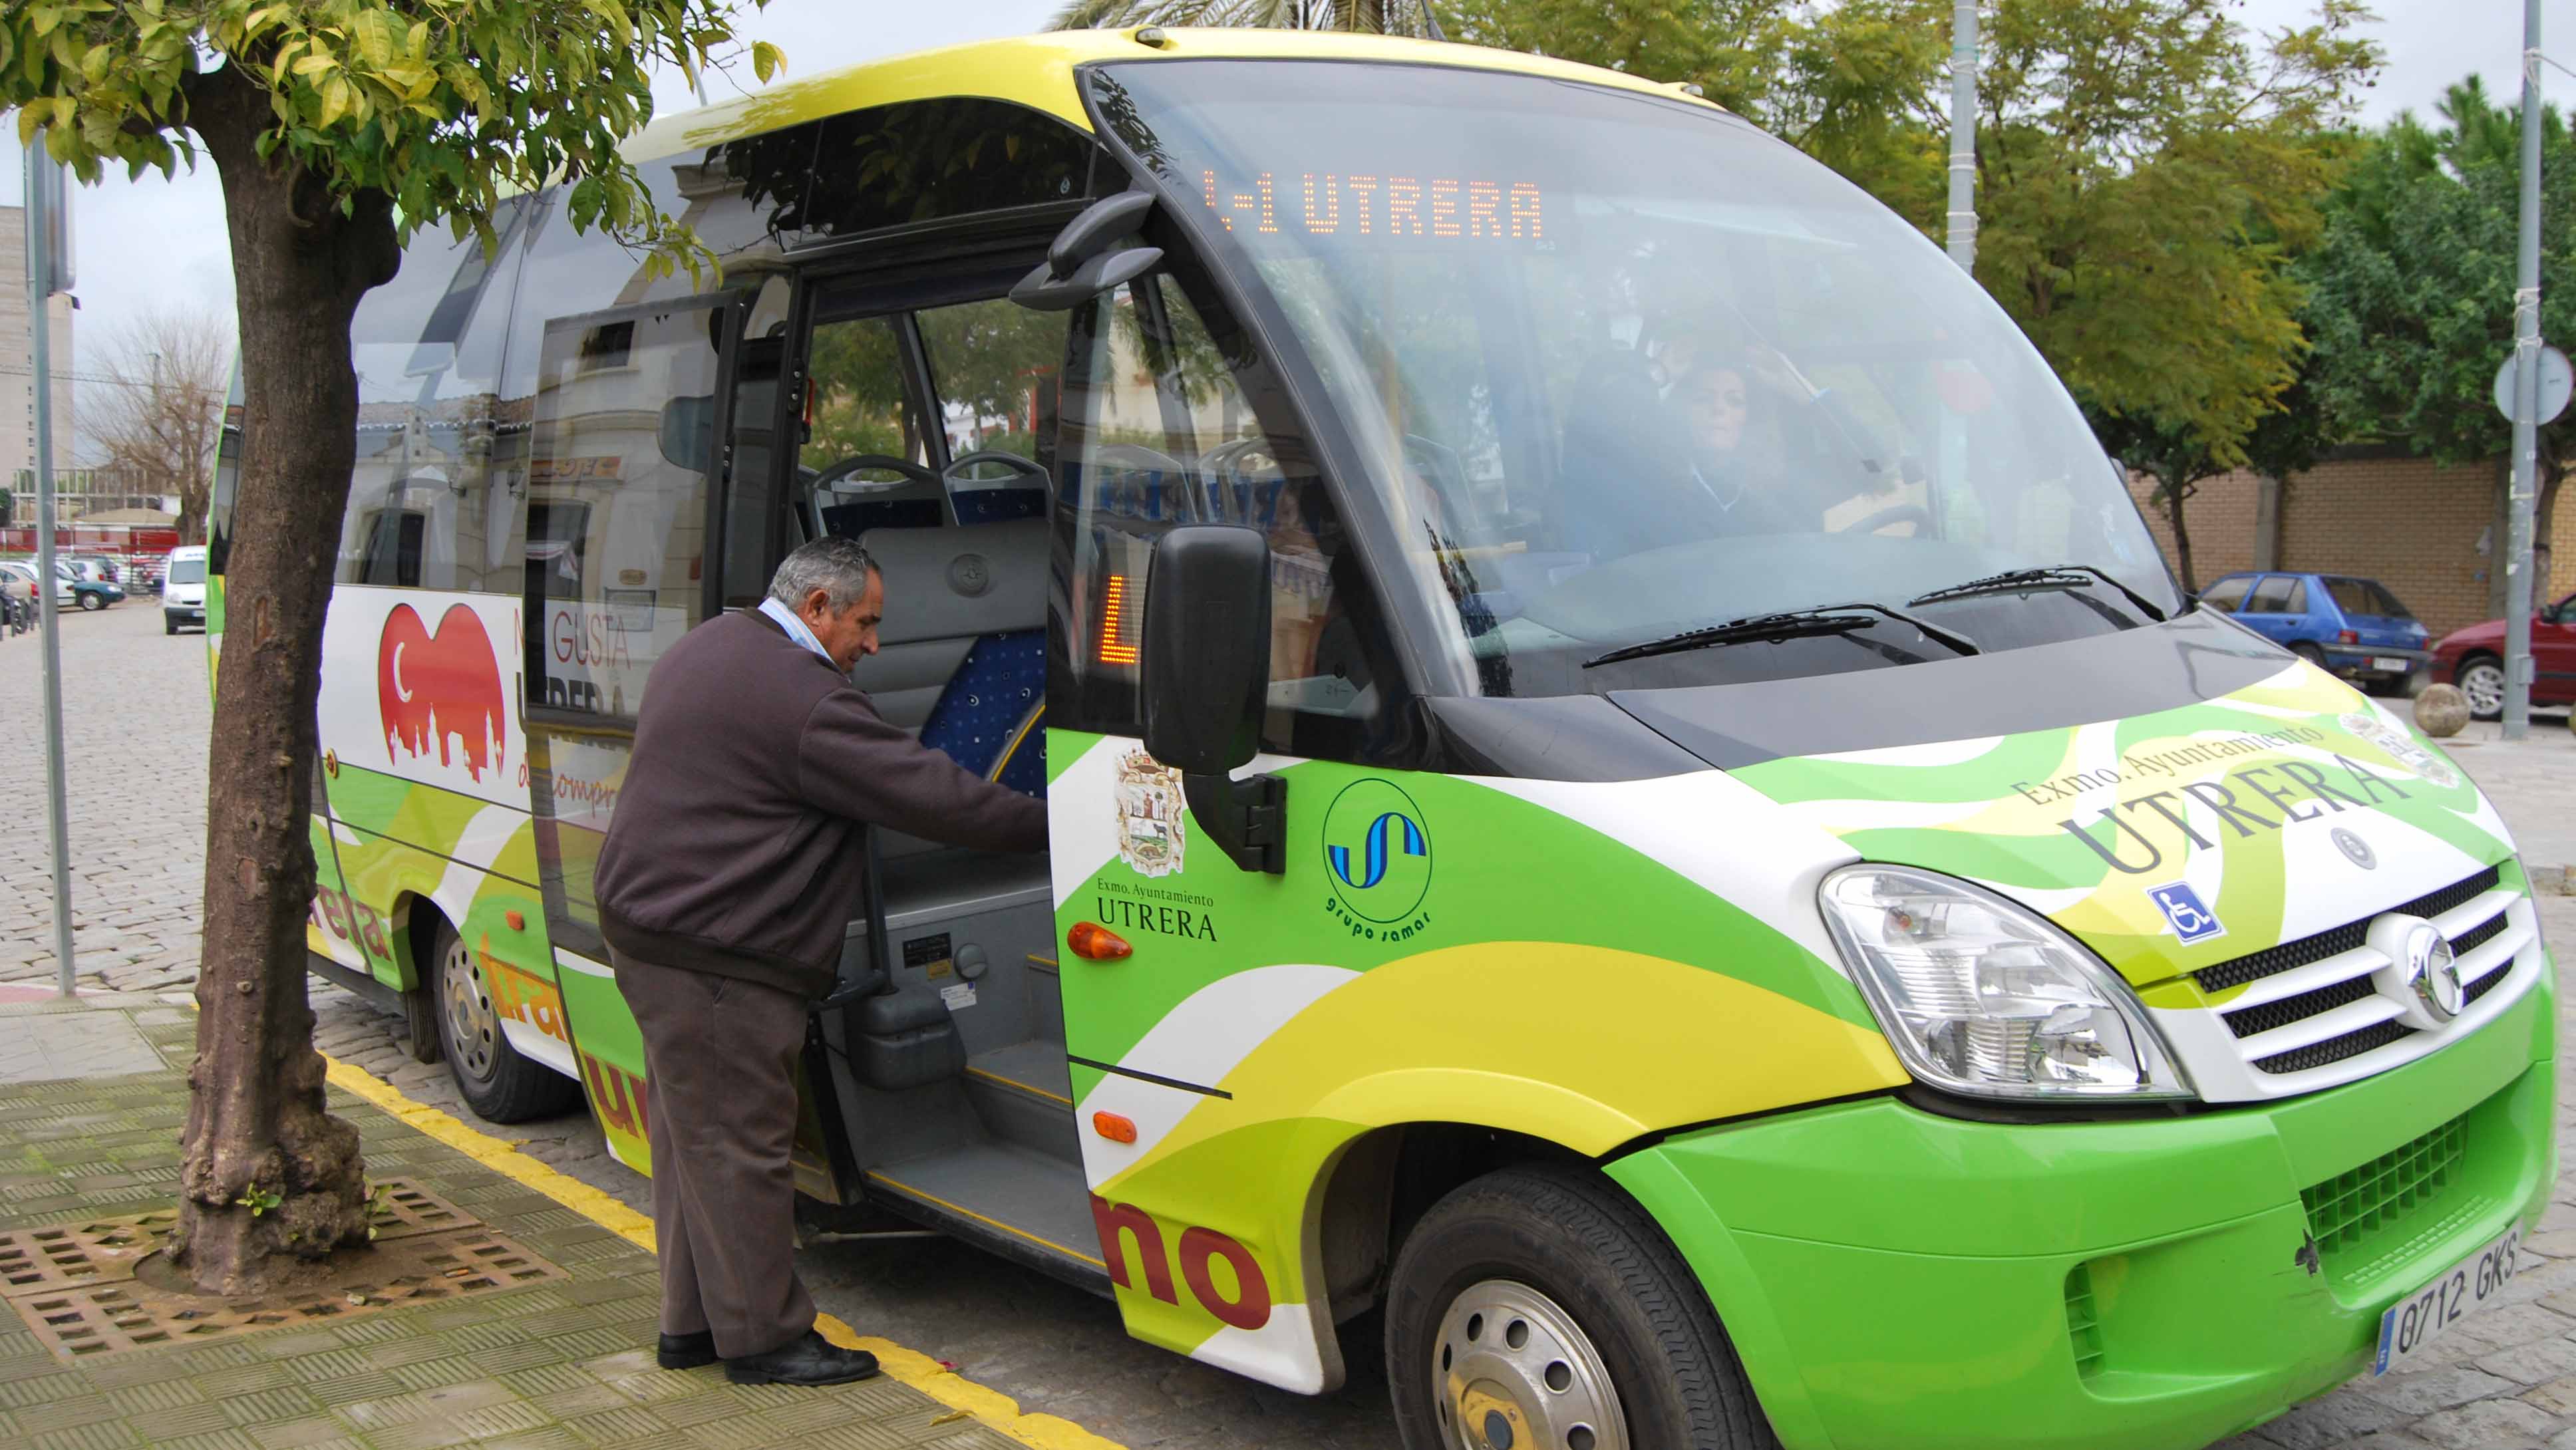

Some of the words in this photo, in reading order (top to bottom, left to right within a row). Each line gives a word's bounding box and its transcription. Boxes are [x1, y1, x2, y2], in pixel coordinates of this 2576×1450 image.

[1303, 172, 1542, 238] UTRERA
[554, 610, 631, 670] GUSTA
[2011, 767, 2133, 806] Exmo.
[2124, 724, 2325, 782] Ayuntamiento
[2057, 753, 2412, 874] UTRERA
[1097, 877, 1130, 895] Exmo.
[1132, 883, 1214, 907] Ayuntamiento
[1097, 896, 1217, 942] UTRERA
[1325, 897, 1374, 940] grupo
[1381, 911, 1431, 942] samar
[2398, 1270, 2466, 1354] 0712
[2476, 1231, 2518, 1301] GKS
